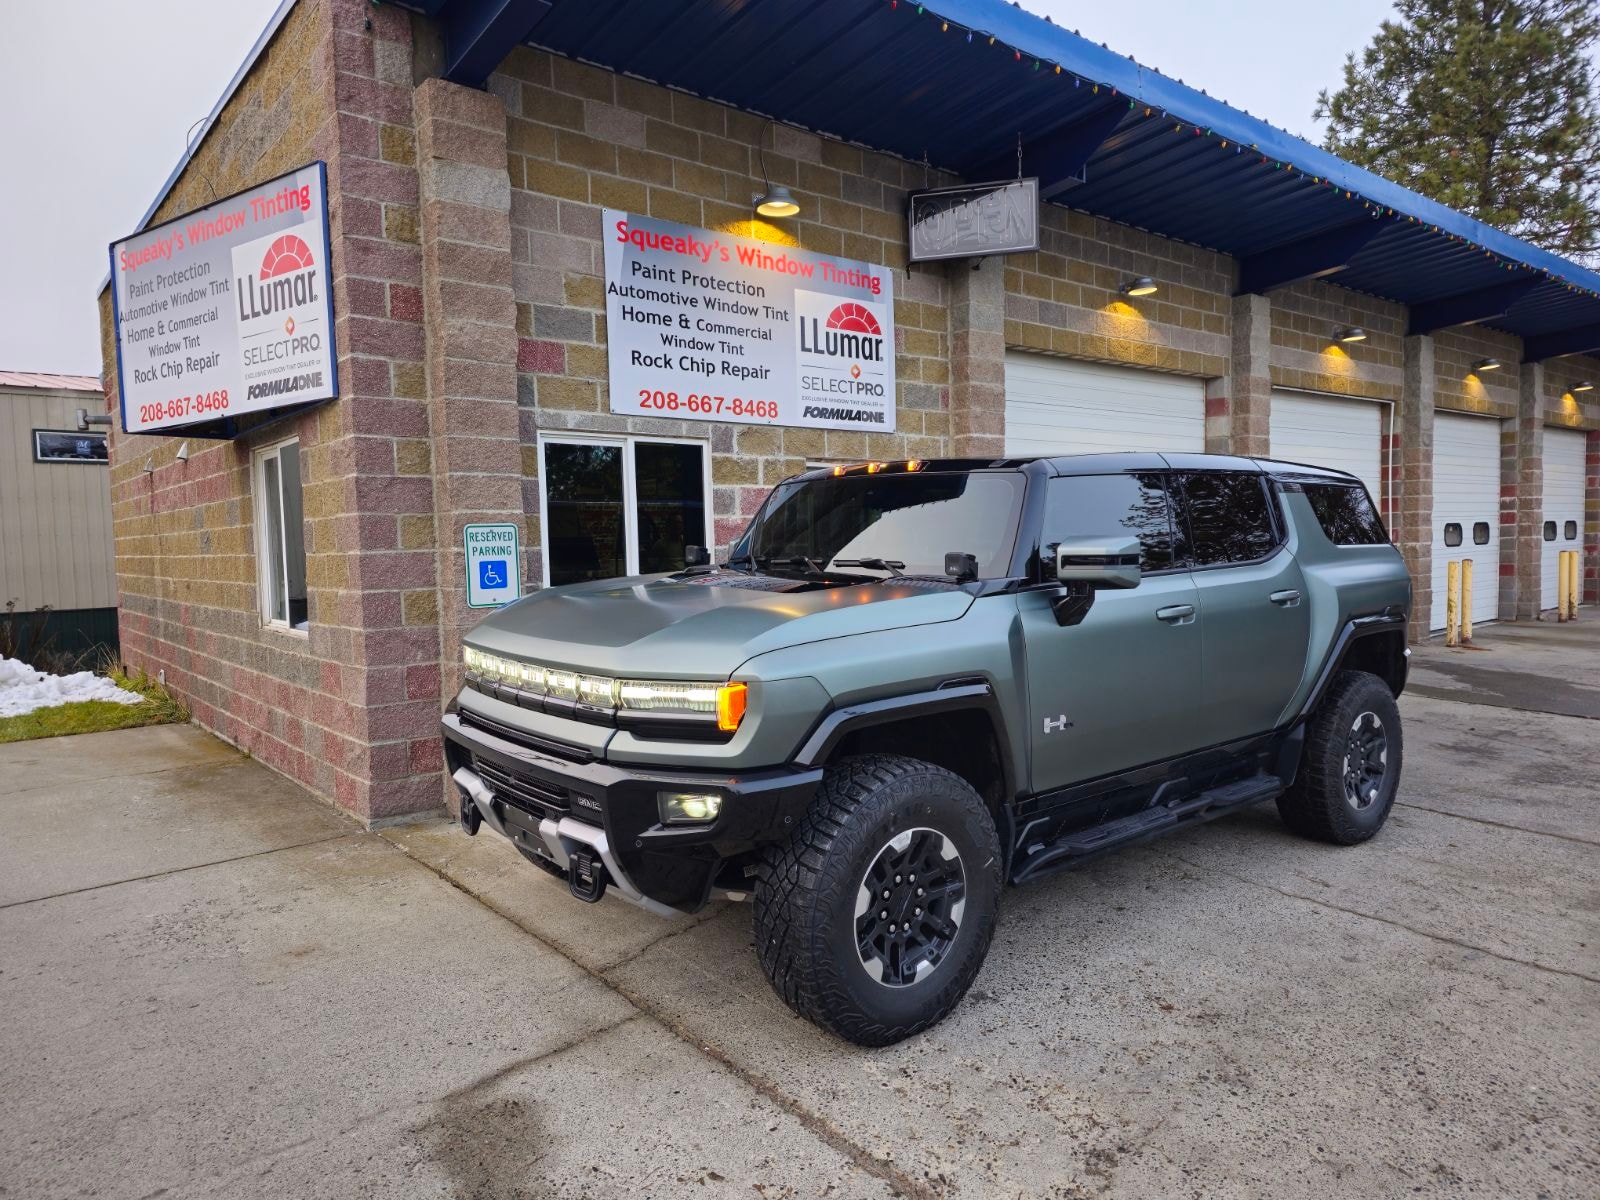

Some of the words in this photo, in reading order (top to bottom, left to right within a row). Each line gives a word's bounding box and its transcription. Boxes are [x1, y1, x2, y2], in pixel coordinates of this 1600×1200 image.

[120, 231, 185, 272] Squeaky's
[185, 209, 247, 246] Window
[248, 184, 311, 222] Tinting
[916, 189, 1033, 250] OPEN
[616, 220, 730, 263] Squeaky's
[736, 244, 815, 278] Window
[819, 262, 882, 295] Tinting
[129, 279, 154, 299] Paint
[156, 262, 211, 290] Protection
[631, 260, 676, 283] Paint
[682, 269, 765, 298] Protection
[119, 300, 169, 324] Automotive
[170, 288, 207, 308] Window
[209, 278, 230, 296] Tint
[607, 281, 699, 308] Automotive
[703, 296, 759, 317] Window
[763, 305, 790, 322] Tint
[127, 325, 155, 344] Home
[157, 320, 165, 336] &
[168, 306, 219, 333] Commercial
[622, 305, 673, 326] Home
[678, 313, 691, 330] &
[696, 318, 772, 341] Commercial
[148, 341, 181, 358] Window
[182, 334, 201, 350] Tint
[660, 333, 715, 352] Window
[718, 341, 745, 356] Tint
[134, 365, 158, 384] Rock
[160, 360, 183, 379] Chip
[186, 351, 220, 374] Repair
[631, 350, 674, 370] Rock
[679, 355, 716, 377] Chip
[721, 361, 771, 381] Repair
[140, 389, 229, 423] 208-667-8468
[639, 389, 779, 419] 208-667-8468
[468, 531, 513, 542] RESERVED
[472, 545, 512, 556] PARKING
